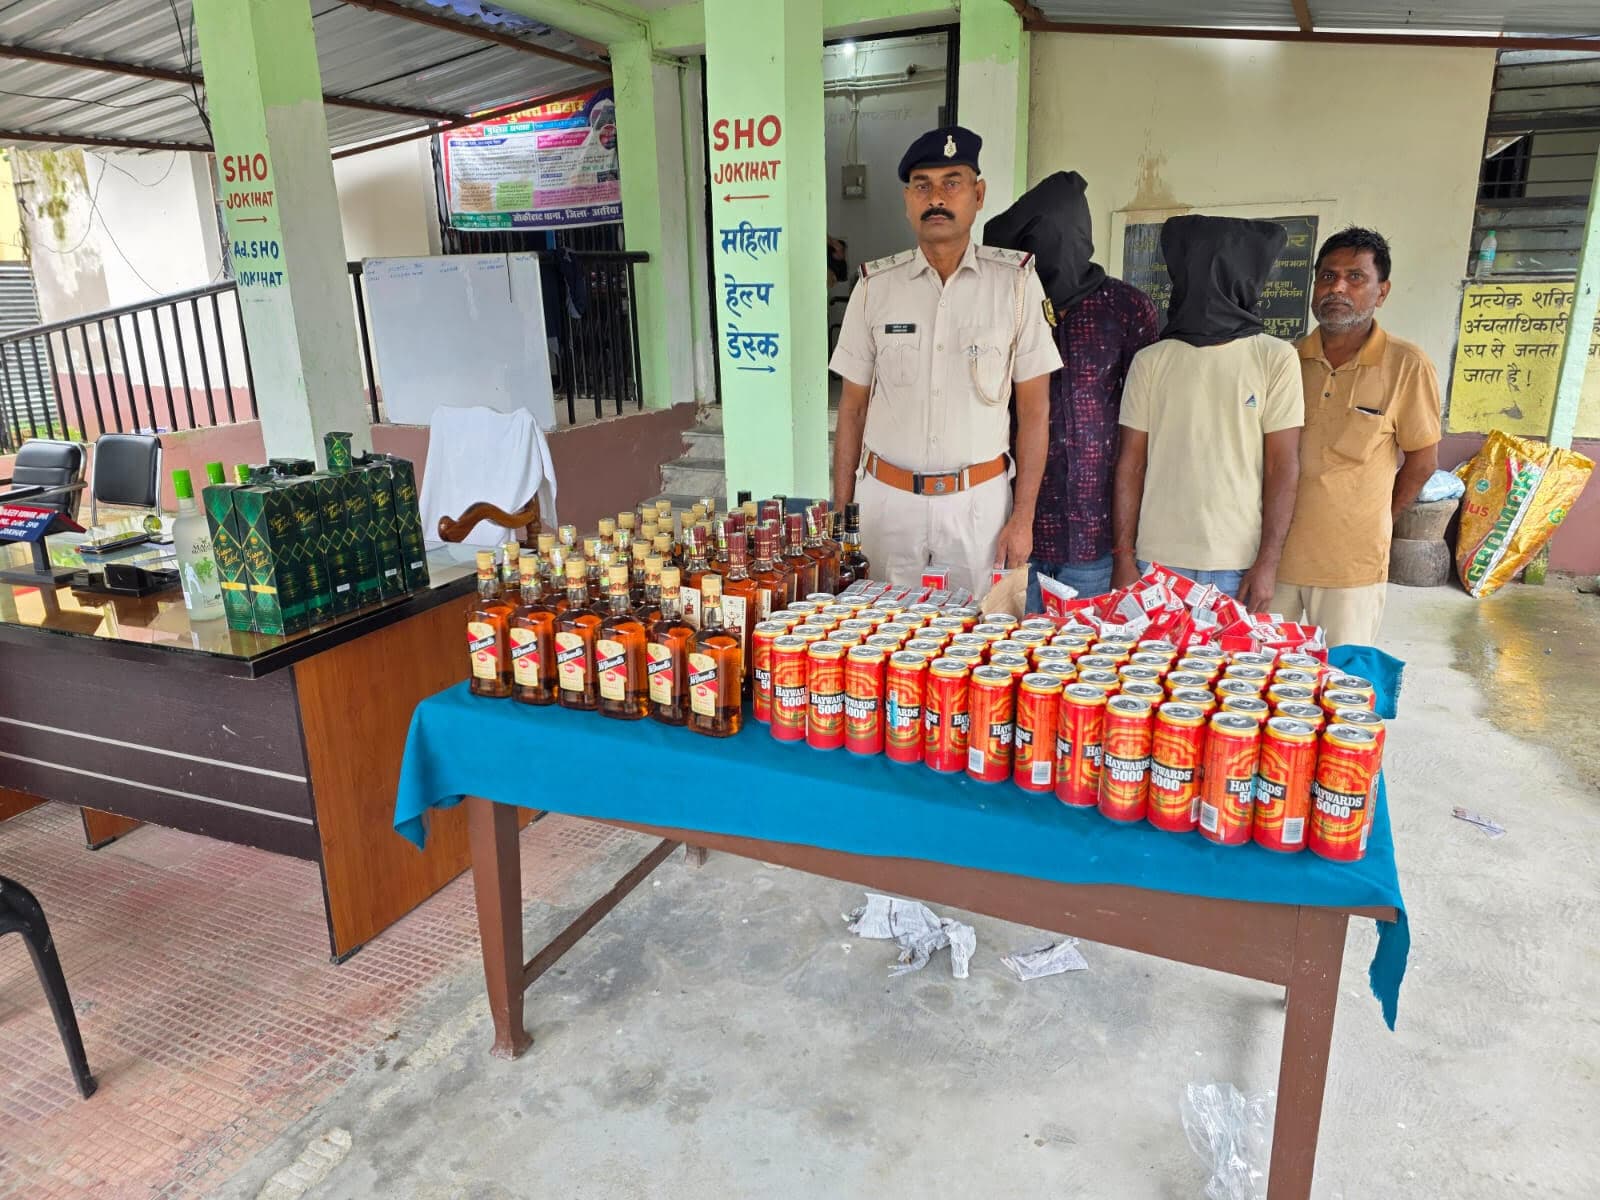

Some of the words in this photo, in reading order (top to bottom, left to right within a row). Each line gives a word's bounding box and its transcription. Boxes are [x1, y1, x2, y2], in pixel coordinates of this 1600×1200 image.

[713, 115, 782, 151] SHO
[223, 153, 268, 183] SHO
[714, 160, 781, 185] JOKIHAT
[226, 191, 274, 210] JOKIHAT
[720, 221, 782, 260] महिला
[238, 271, 283, 288] JOKIHAT
[724, 274, 774, 317] हेल्प
[1469, 287, 1523, 308] प्रत्येक
[726, 323, 779, 361] डेस्क
[1491, 338, 1506, 359] से
[1513, 344, 1559, 359] जनता
[1464, 368, 1503, 384] जाता
[1467, 470, 1540, 582] GROMOR
[818, 704, 844, 715] 5000
[1111, 768, 1144, 782] 5000
[1151, 771, 1180, 791] 5000
[1316, 798, 1351, 818] 5000
